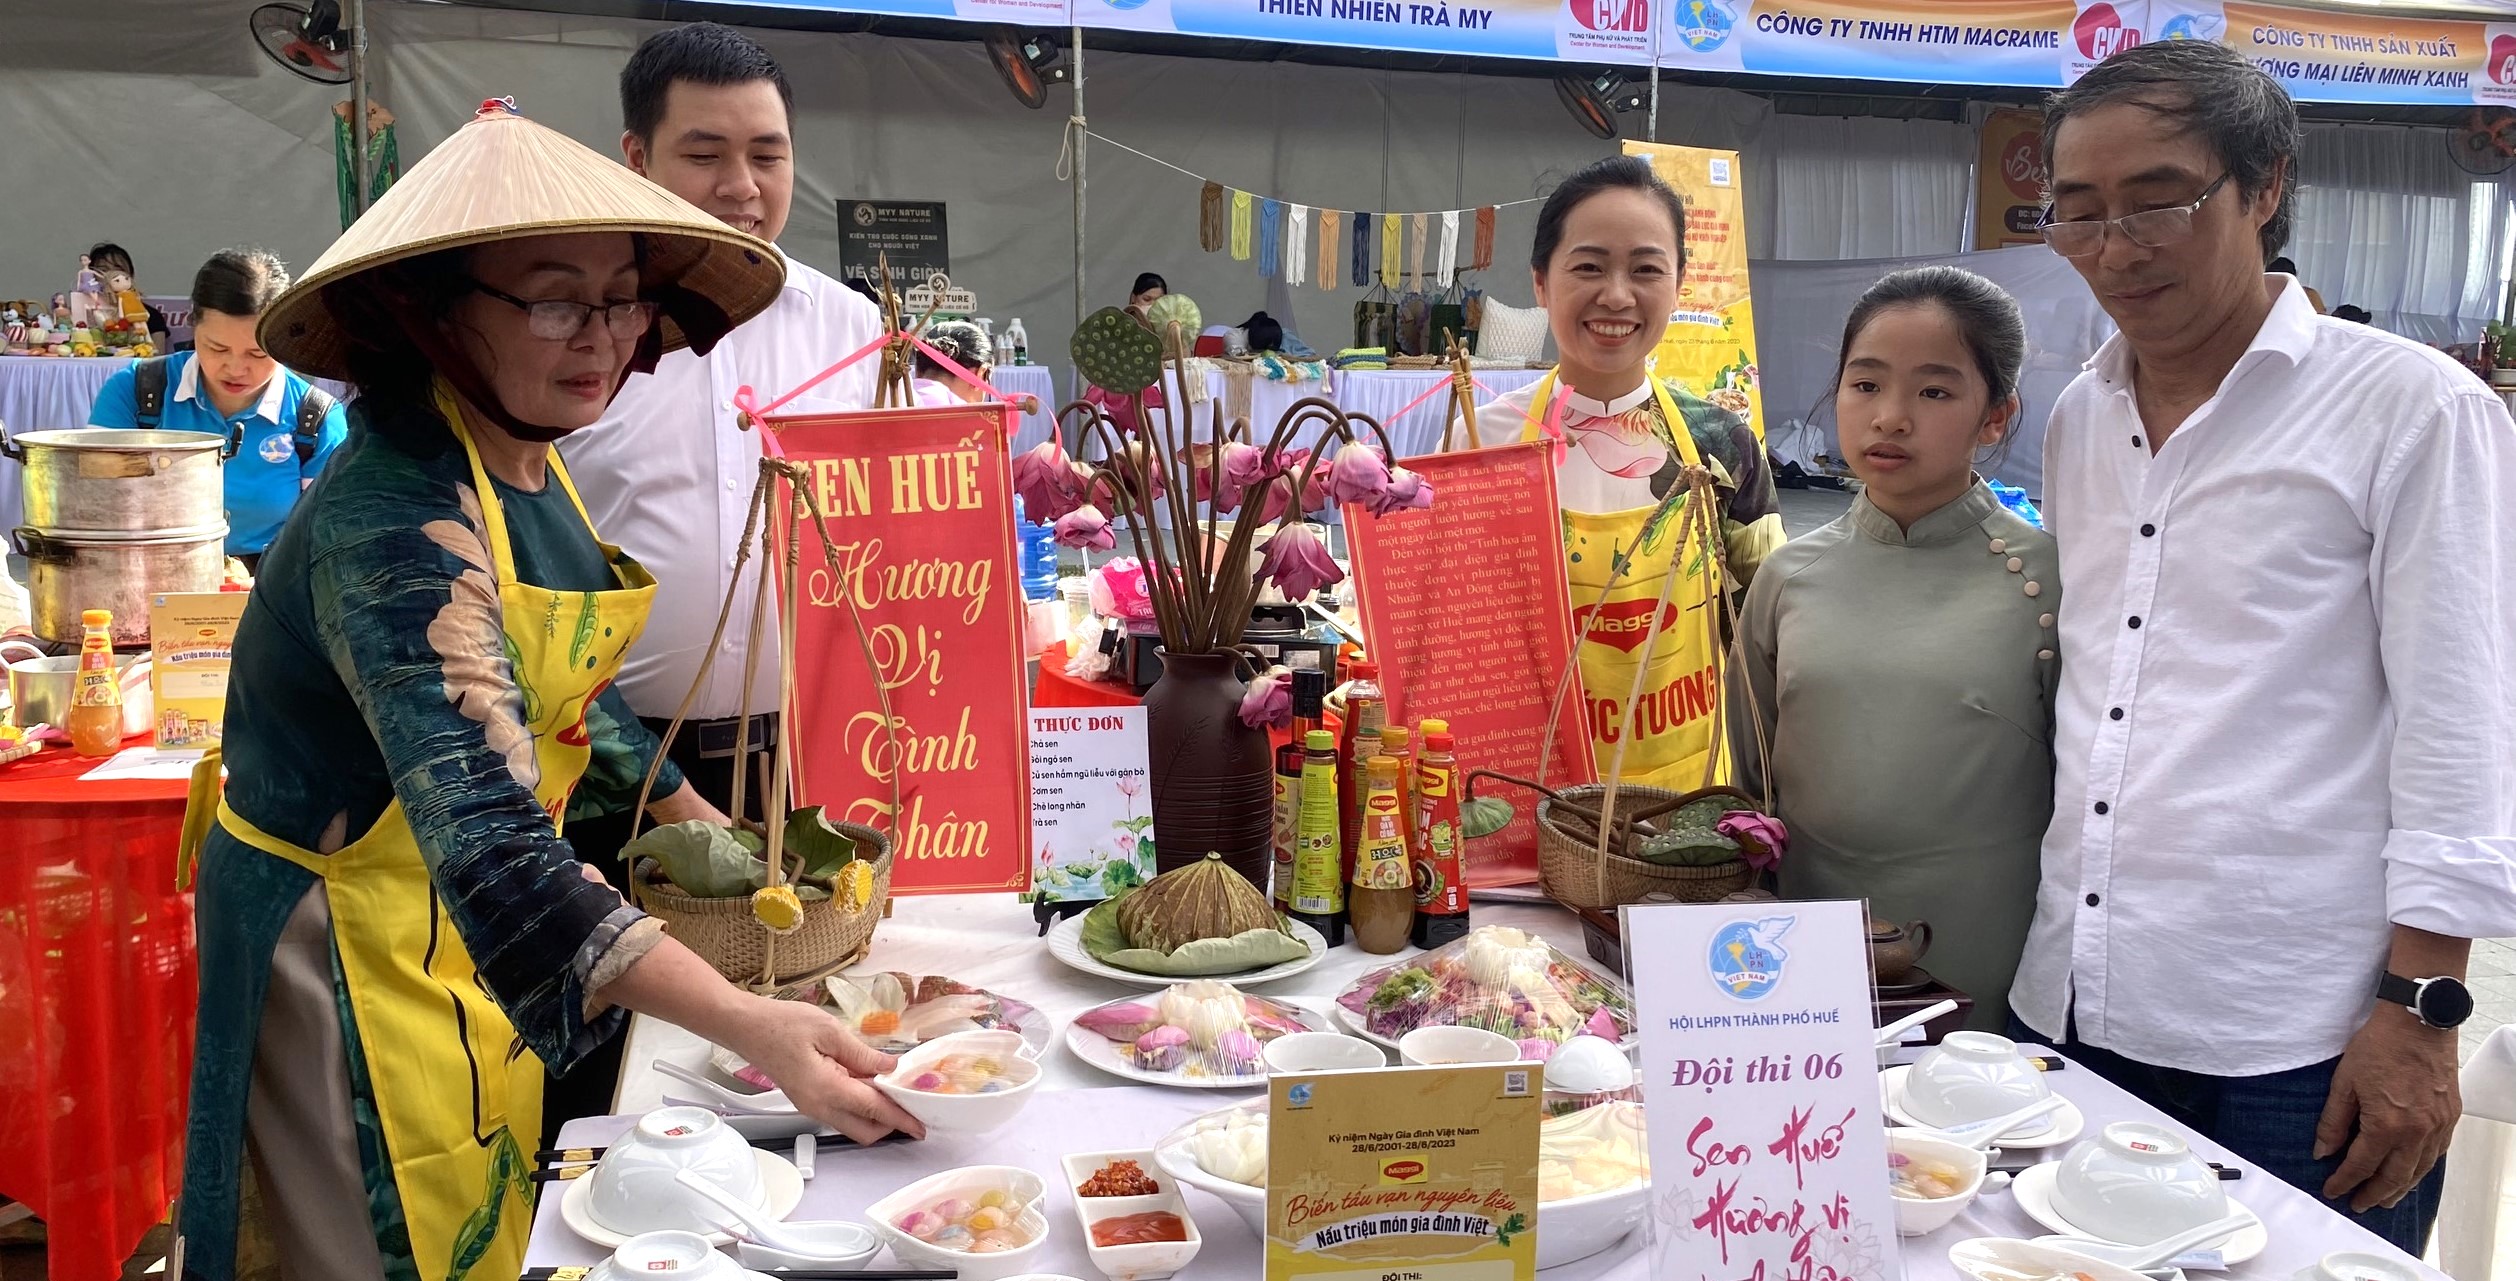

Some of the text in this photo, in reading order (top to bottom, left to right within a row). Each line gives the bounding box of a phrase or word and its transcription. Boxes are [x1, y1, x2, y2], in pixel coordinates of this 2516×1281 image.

[1409, 1, 1450, 27] TRÀ
[1459, 8, 1492, 29] MY
[1756, 11, 2059, 48] CÔNG TY TNHH HTM MACRAME
[2253, 24, 2457, 57] CÔNG TY TNHH SẢN XUẤT
[2305, 61, 2468, 88] MẠI LIÊN MINH XANH
[899, 209, 930, 217] NATURE
[870, 266, 906, 279] SNH
[786, 429, 984, 519] SEN HUẾ
[1436, 514, 1458, 524] luôn
[1516, 506, 1533, 514] sau
[1501, 534, 1519, 544] hoa
[809, 538, 992, 626] Hương
[1385, 578, 1417, 590] thuộc
[1387, 586, 1461, 605] Nhuận An
[1406, 622, 1424, 633] sen
[1466, 612, 1493, 624] mang
[1581, 610, 1664, 632] Magg
[869, 624, 943, 697] Vị
[1397, 654, 1428, 664] mang
[1034, 715, 1124, 734] THỰC ĐƠN
[844, 706, 979, 784] Tình
[1106, 768, 1117, 776] với
[1048, 802, 1064, 812] long
[1066, 801, 1085, 809] nhãn
[844, 795, 990, 872] Thân
[1749, 952, 1762, 960] LH
[1750, 960, 1764, 968] PN
[1748, 973, 1766, 982] NAM
[1669, 1007, 1840, 1032] HỘI LHPN THÀNH PHỐ HUẾ
[1671, 1052, 1844, 1093] Đội thi 06
[1343, 1132, 1367, 1142] niệm
[1368, 1130, 1394, 1142] Ngày
[1395, 1129, 1412, 1139] Gia
[1413, 1129, 1434, 1138] đình
[1436, 1128, 1456, 1139] Việt
[1457, 1127, 1479, 1135] Nam
[1352, 1139, 1456, 1153] 28/6/2001-28/6/2023
[1686, 1117, 1751, 1177] Sen
[1388, 1164, 1420, 1175] Maggi
[1287, 1184, 1518, 1227] Biến tấu vạn nguyên liệu
[1316, 1215, 1489, 1248] Nấu triệu món gia đình Việt
[1402, 1272, 1422, 1280] THI:
